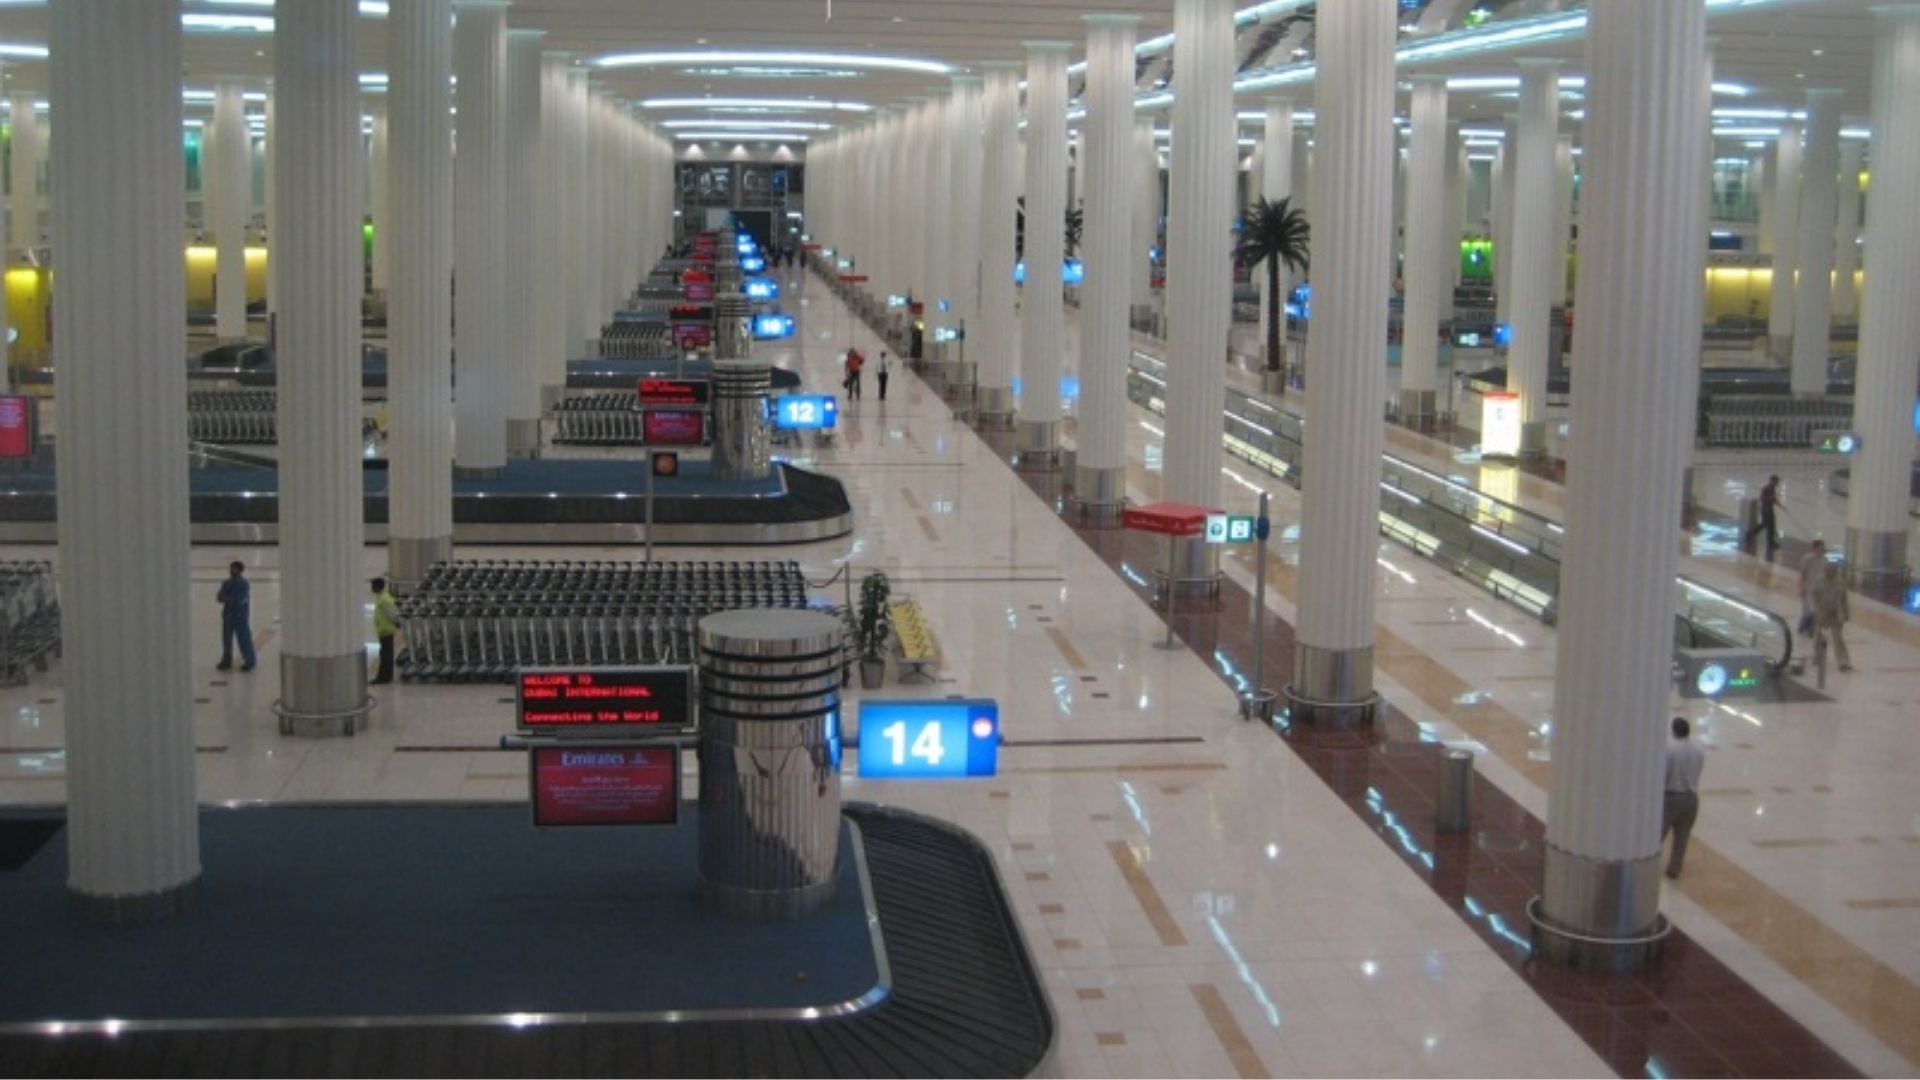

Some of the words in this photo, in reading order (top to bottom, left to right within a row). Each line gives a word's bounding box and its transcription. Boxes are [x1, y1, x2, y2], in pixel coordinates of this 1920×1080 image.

[787, 401, 815, 423] 12
[523, 675, 571, 685] WELCOME
[577, 674, 593, 685] TO
[597, 711, 619, 721] the
[623, 710, 660, 721] World
[882, 720, 945, 766] 14
[561, 751, 625, 766] Emirates
